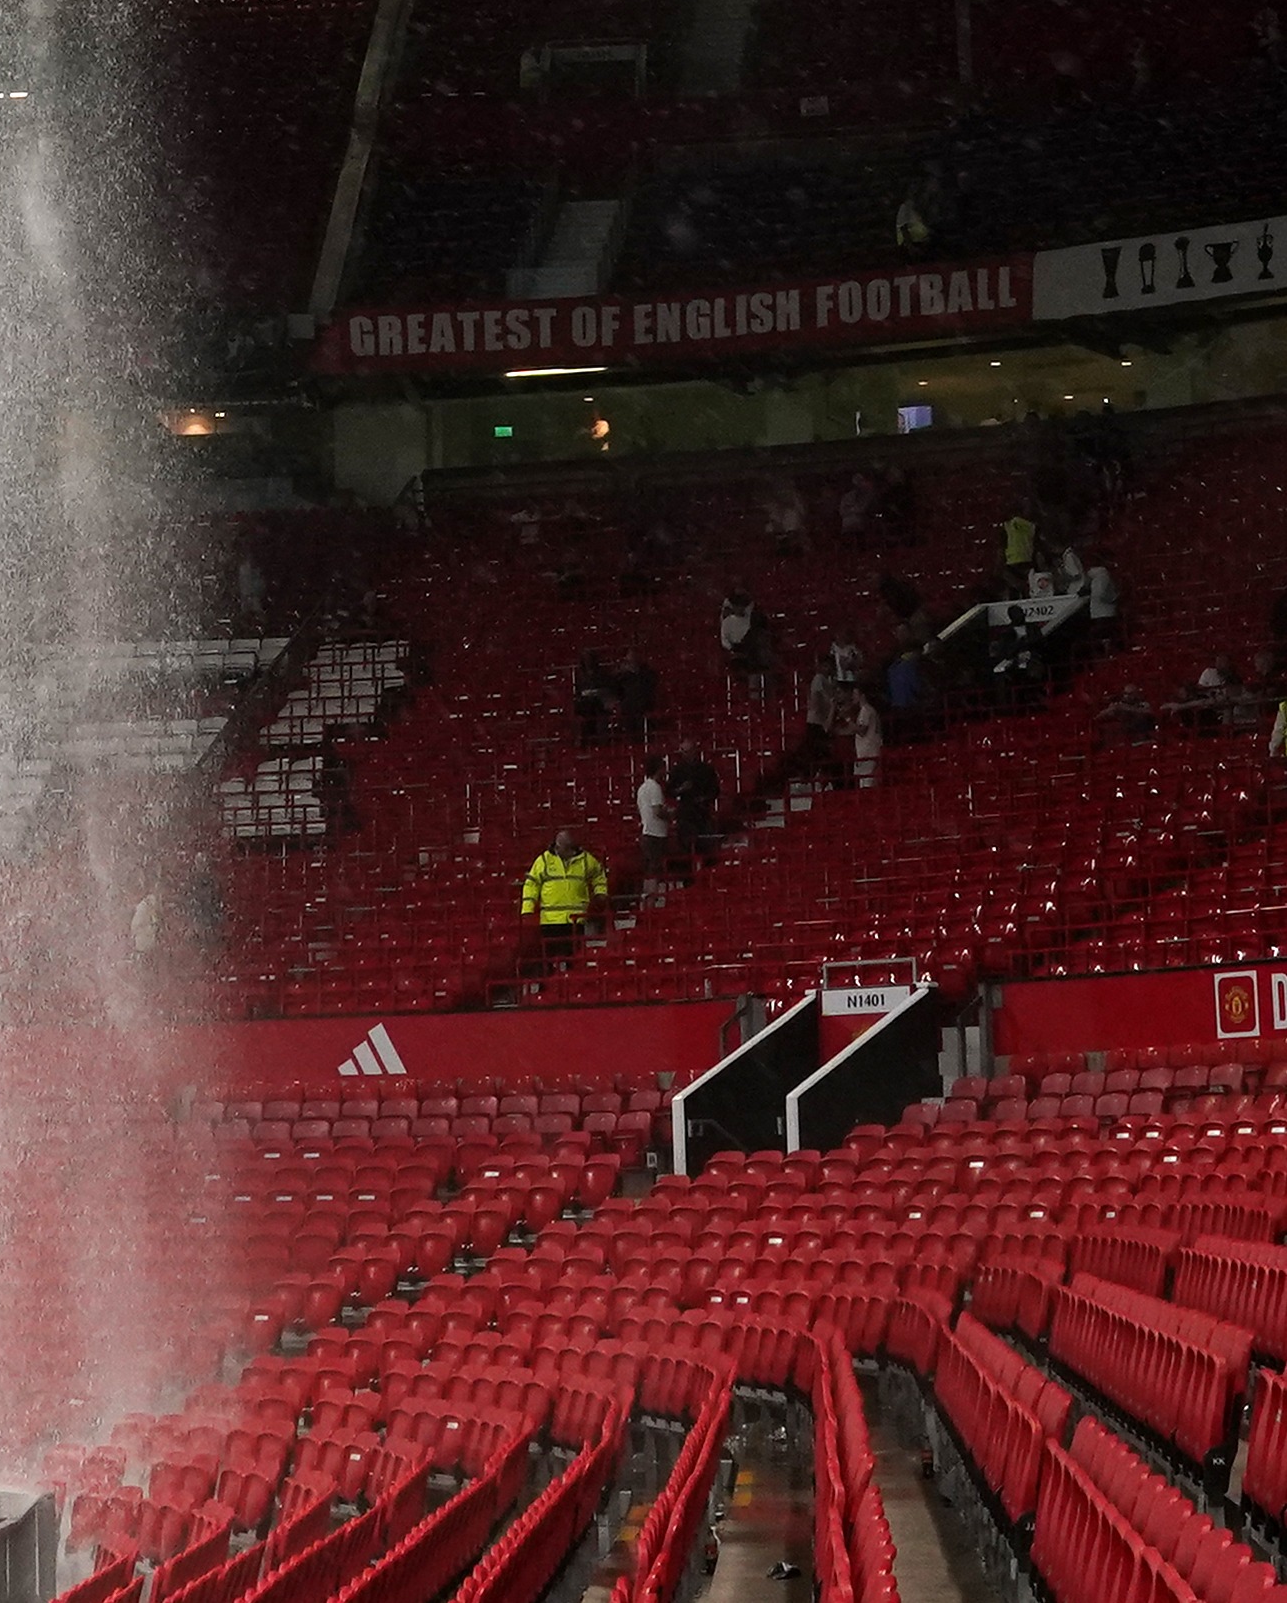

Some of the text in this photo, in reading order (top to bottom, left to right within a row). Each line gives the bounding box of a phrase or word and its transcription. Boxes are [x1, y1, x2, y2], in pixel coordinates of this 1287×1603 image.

[349, 265, 1017, 357] GREATEST OF ENGLISH FOOTBALL
[847, 994, 885, 1008] N1401
